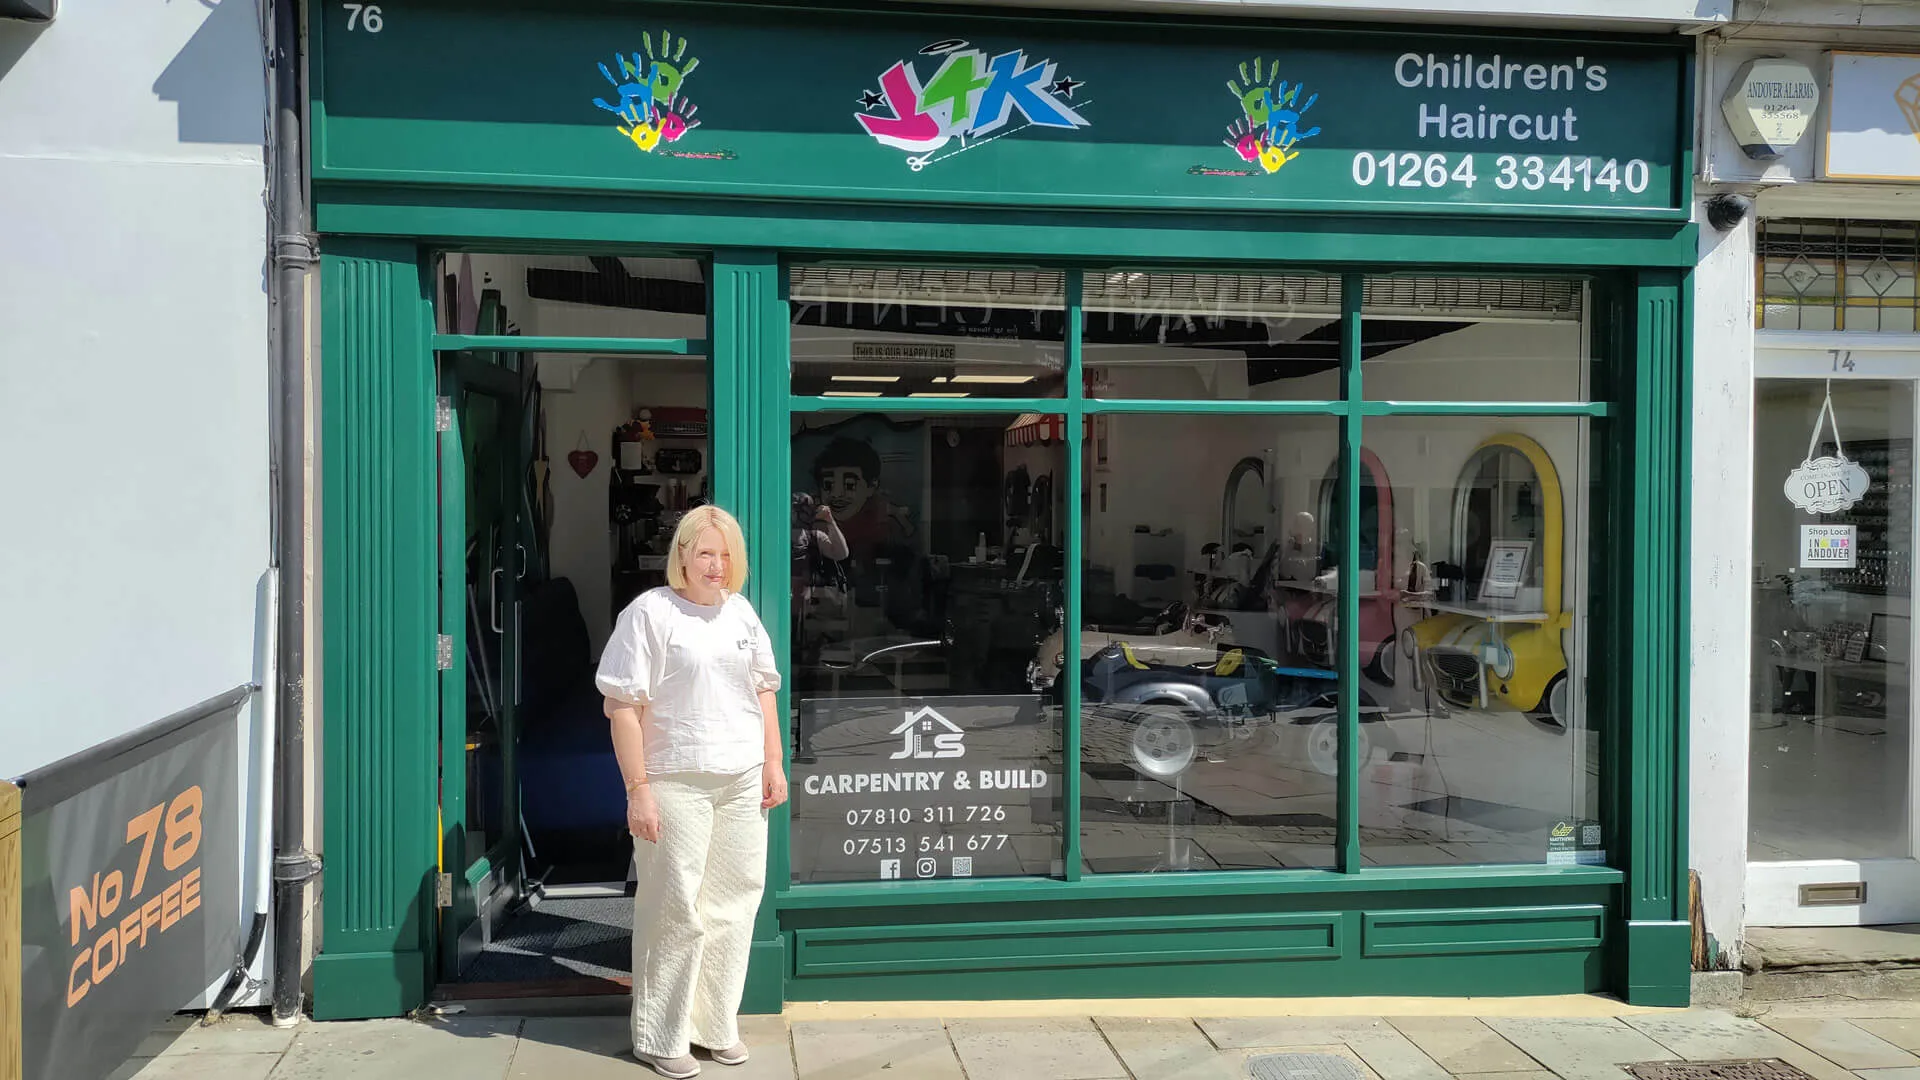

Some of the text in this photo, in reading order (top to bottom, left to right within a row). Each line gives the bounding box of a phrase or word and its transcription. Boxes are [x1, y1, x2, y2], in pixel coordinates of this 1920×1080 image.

[343, 3, 383, 33] 76
[1394, 53, 1608, 92] Children's
[1747, 82, 1815, 99] ANDOVER ALARMS
[1418, 103, 1579, 142] Haircut
[1352, 151, 1650, 194] 01264 334140
[903, 347, 928, 359] HAPPY
[1828, 350, 1855, 372] 74
[1804, 478, 1850, 499] OPEN
[1808, 528, 1850, 536] Shop Local
[1808, 548, 1850, 559] ANDOVER
[1809, 539, 1820, 548] IN
[889, 726, 966, 760] JLS
[804, 769, 1048, 795] CARPENTRY & BUILD
[846, 805, 1006, 826] 07810 311 726
[843, 834, 1009, 855] 07513 541 677
[69, 785, 203, 947] No 78
[67, 866, 201, 1009] COFFEE
